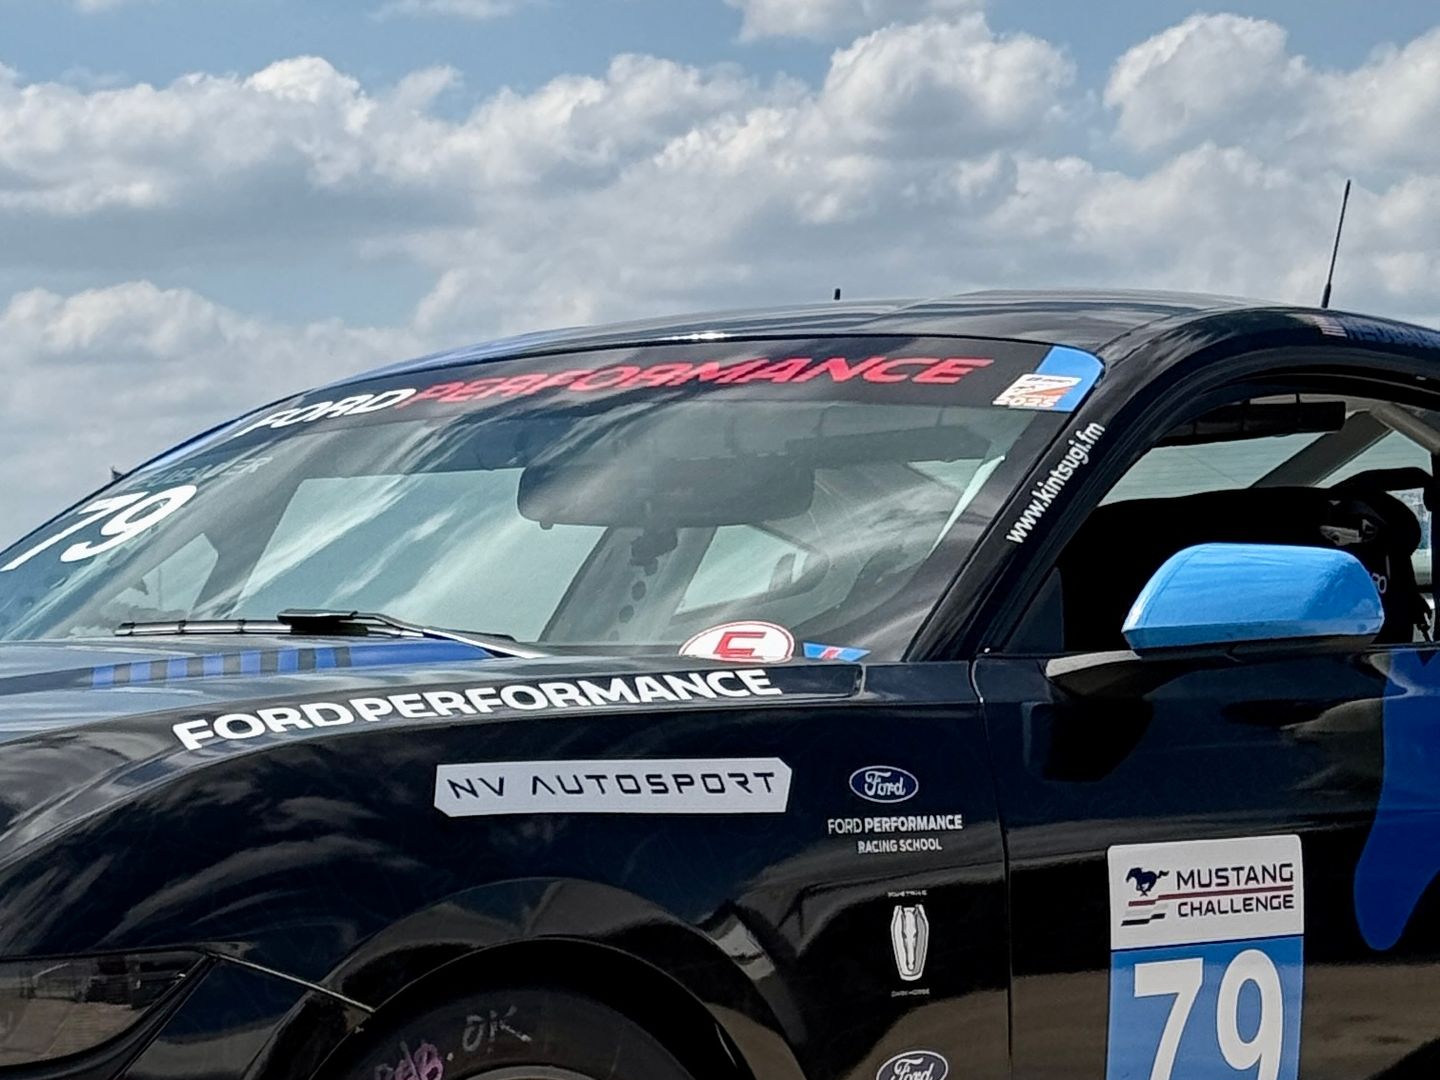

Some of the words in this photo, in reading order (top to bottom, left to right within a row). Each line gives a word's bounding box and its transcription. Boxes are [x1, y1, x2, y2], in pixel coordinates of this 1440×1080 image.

[1006, 421, 1106, 545] www.kintsugi.fm
[0, 485, 197, 572] 79
[446, 775, 506, 799] NV
[531, 771, 776, 797] AUTOSPORT
[864, 771, 906, 796] Ford
[827, 818, 862, 834] FORD
[864, 814, 963, 833] PERFORMANCE
[858, 840, 898, 854] RACING
[900, 838, 942, 852] SCHOOL
[1176, 863, 1294, 891] MUSTANG
[1177, 894, 1295, 918] CHALLENGE
